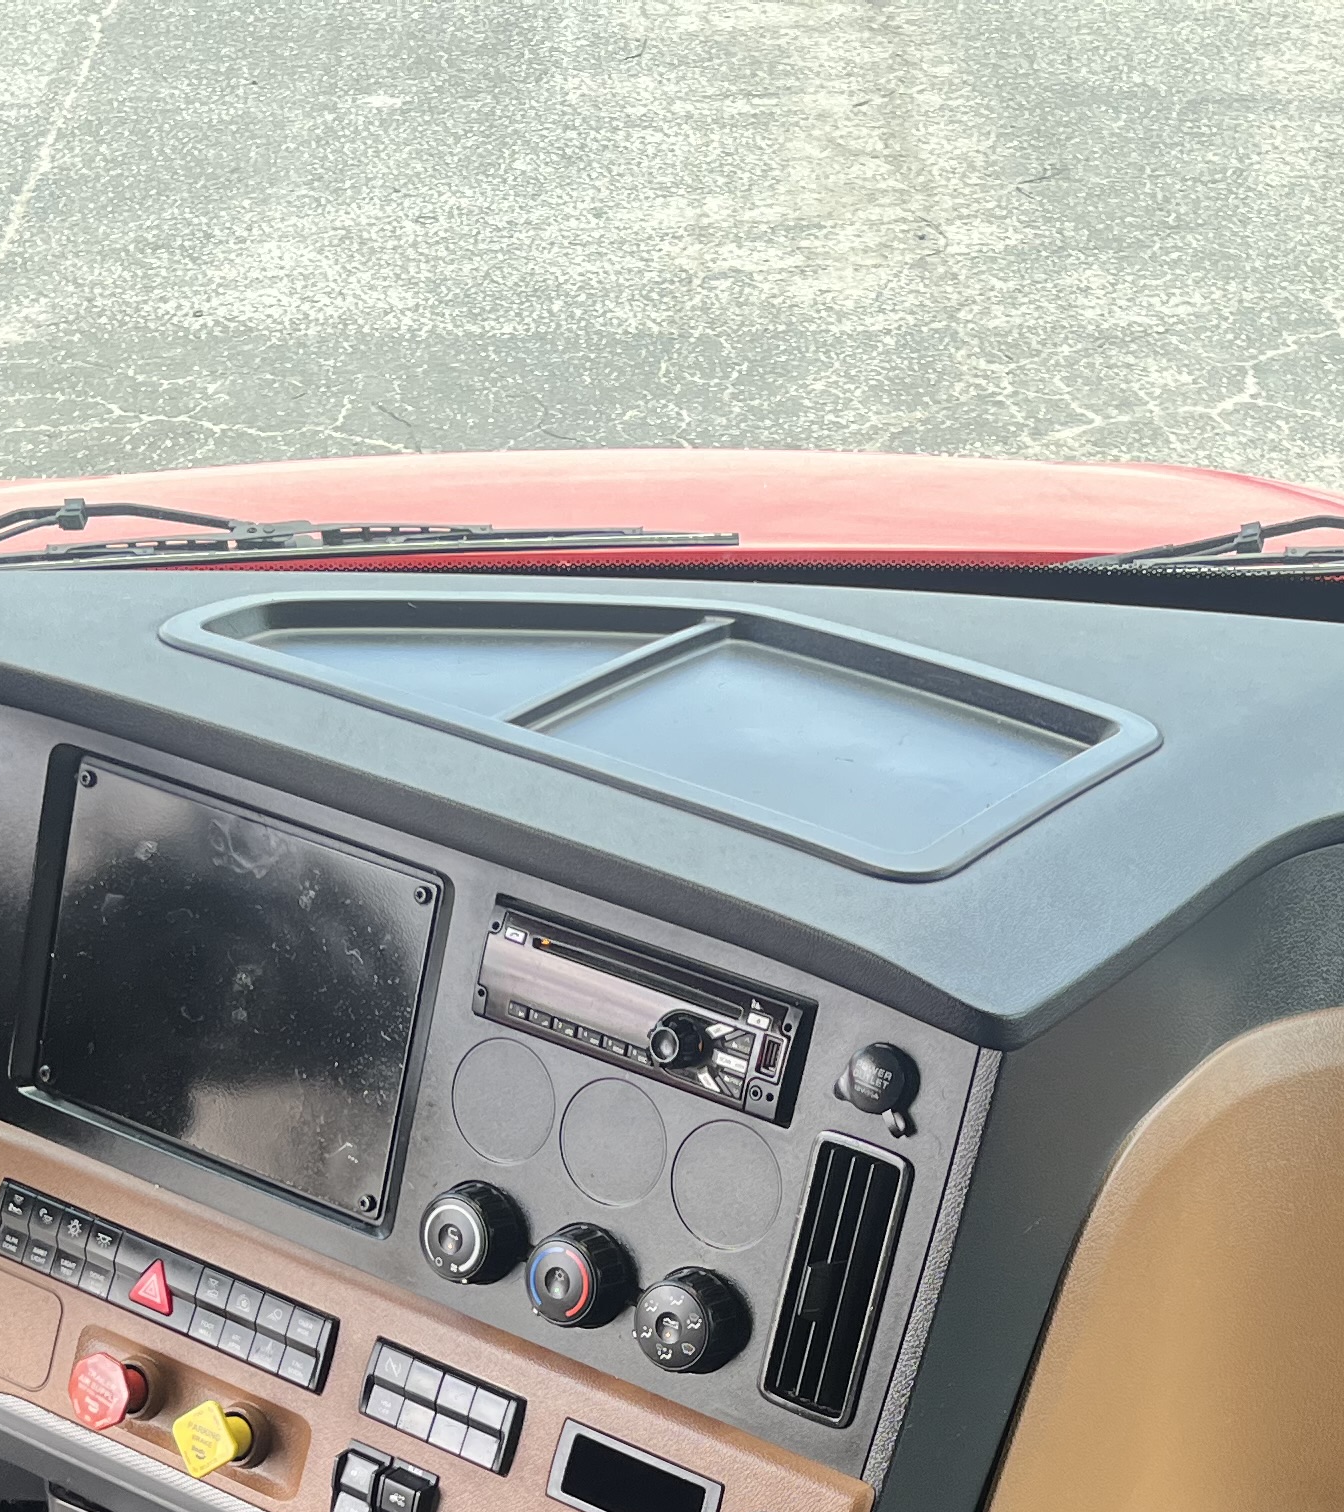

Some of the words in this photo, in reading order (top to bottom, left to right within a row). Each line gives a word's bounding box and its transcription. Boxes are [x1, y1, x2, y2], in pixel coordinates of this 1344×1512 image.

[852, 1068, 890, 1090] OUTLET
[856, 1059, 893, 1081] POWER
[78, 1373, 91, 1386] AIR
[87, 1367, 118, 1391] TRAILER
[187, 1421, 222, 1441] PARKING
[191, 1434, 213, 1448] BRAKE
